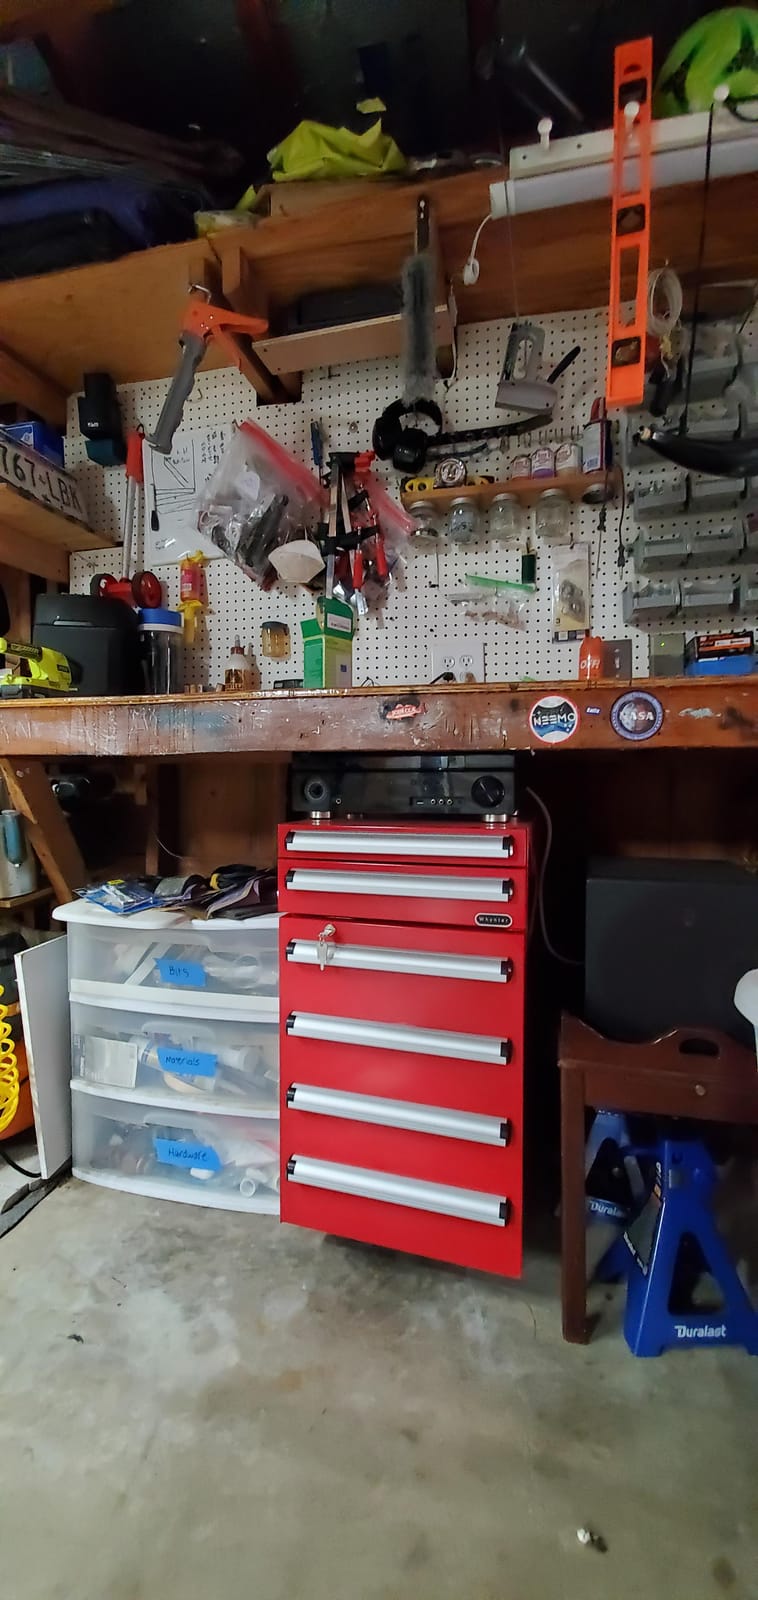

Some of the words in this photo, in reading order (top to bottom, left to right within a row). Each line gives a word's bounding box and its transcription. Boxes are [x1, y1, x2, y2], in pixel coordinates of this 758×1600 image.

[619, 711, 655, 721] NASA
[167, 1147, 208, 1162] Hardware
[674, 1324, 727, 1338] Duralast
